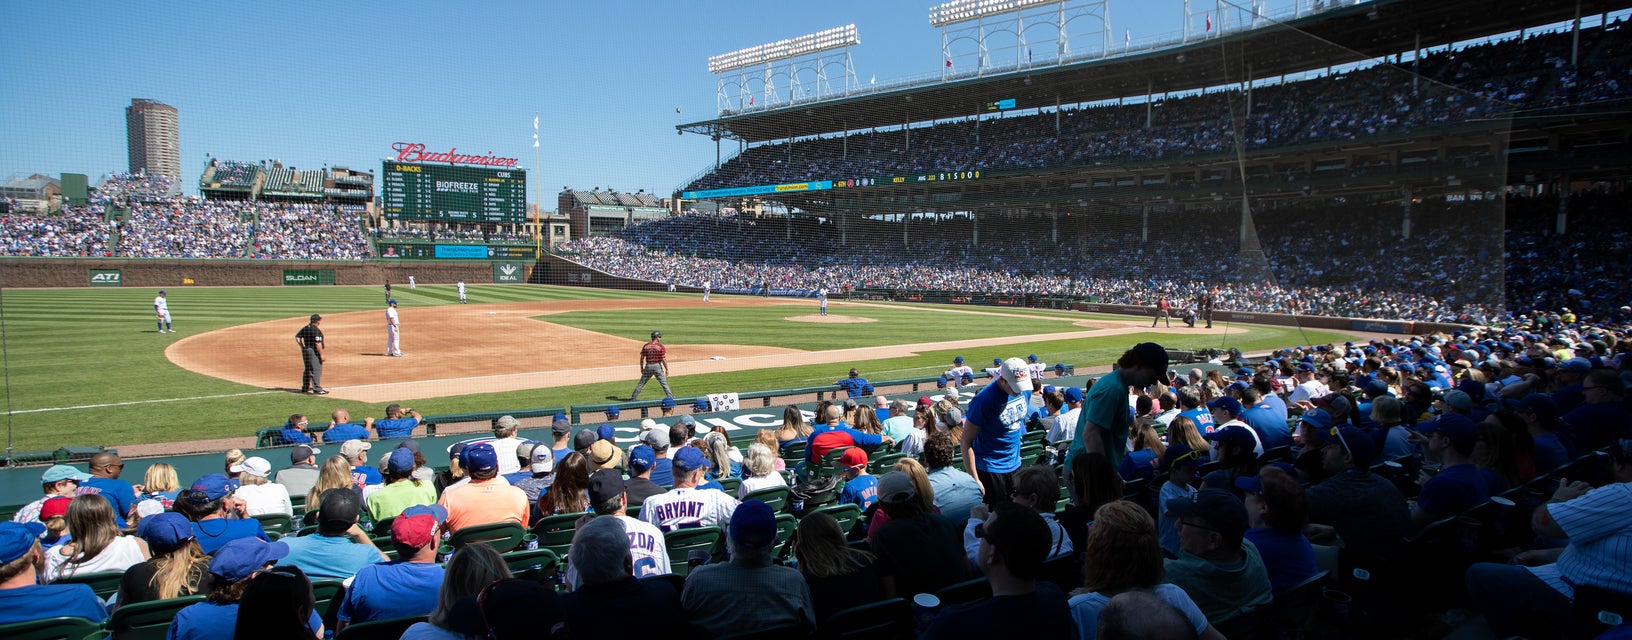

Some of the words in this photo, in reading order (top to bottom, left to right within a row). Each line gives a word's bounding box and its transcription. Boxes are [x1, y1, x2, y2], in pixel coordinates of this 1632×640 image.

[392, 142, 518, 167] Budweiser
[656, 501, 704, 521] BRYANT
[626, 532, 655, 552] ZOR
